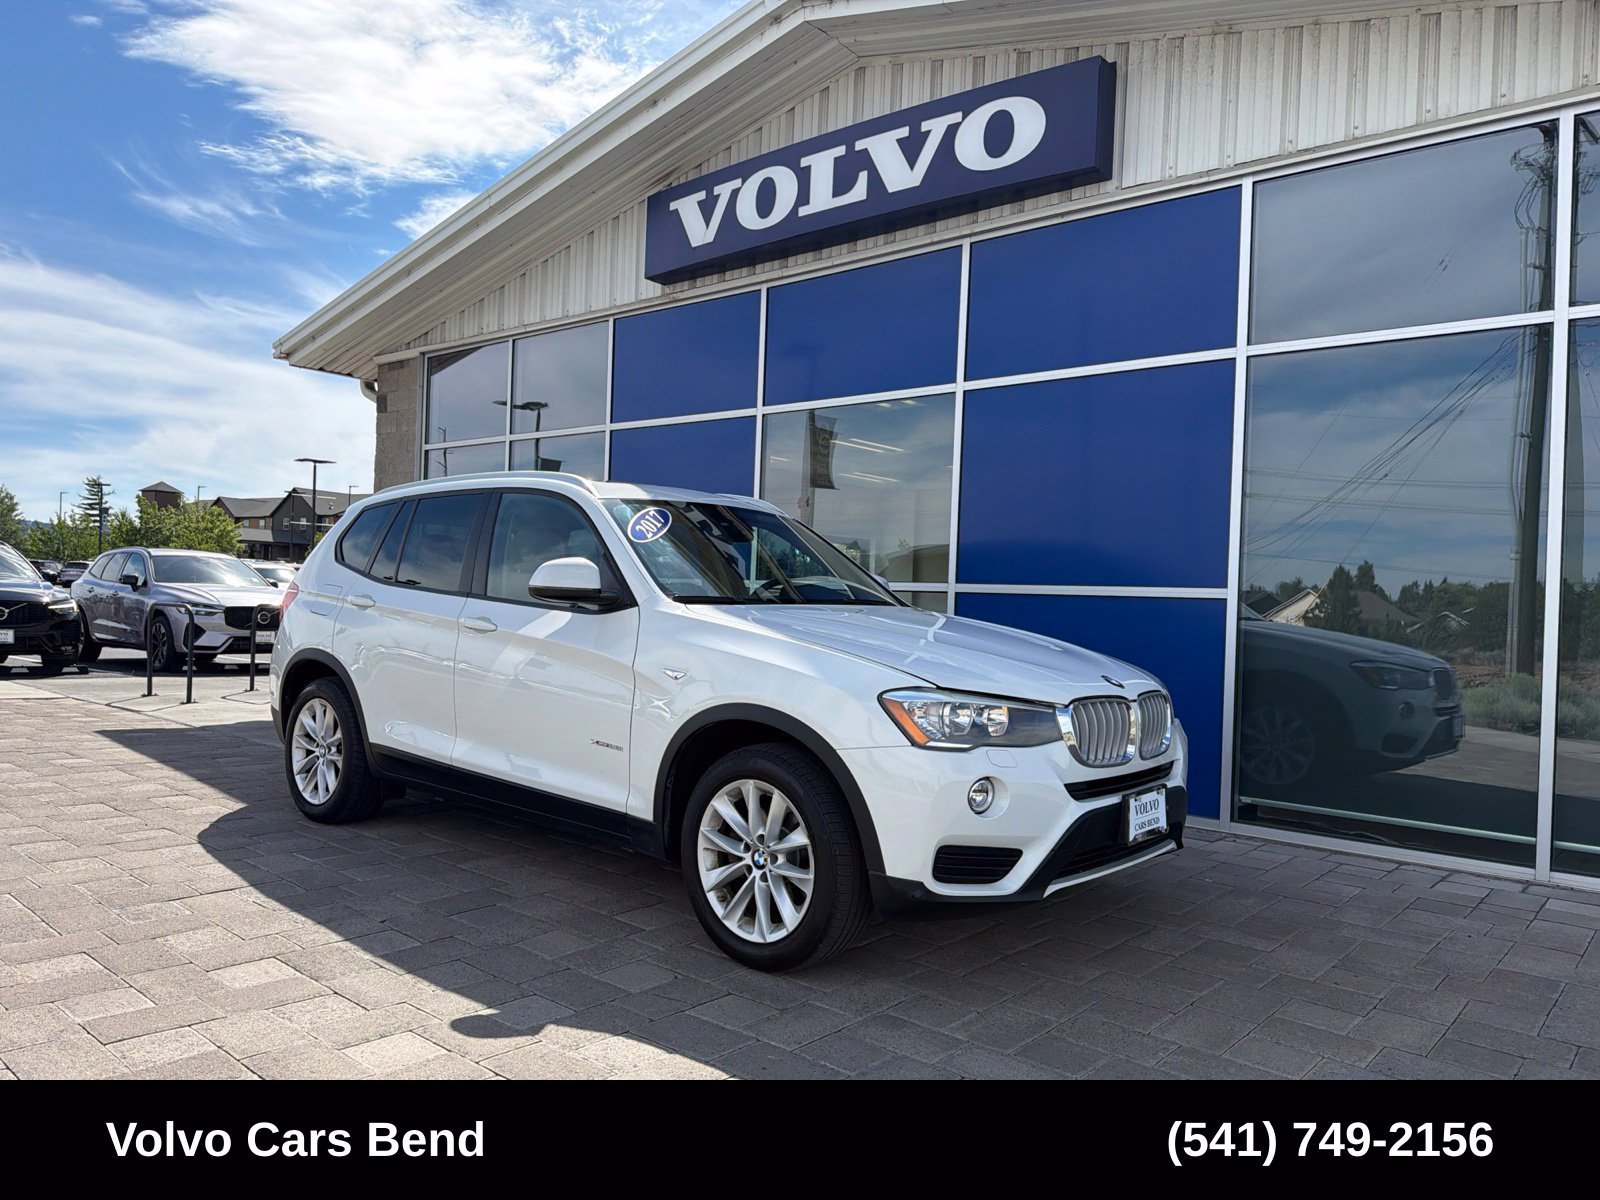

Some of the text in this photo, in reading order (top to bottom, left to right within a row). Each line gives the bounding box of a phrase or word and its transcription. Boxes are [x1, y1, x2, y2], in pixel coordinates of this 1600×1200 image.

[669, 96, 1047, 248] VOLVO
[635, 510, 664, 539] 2017
[1134, 798, 1160, 816] VOLVO
[1134, 816, 1160, 832] CARS BEND
